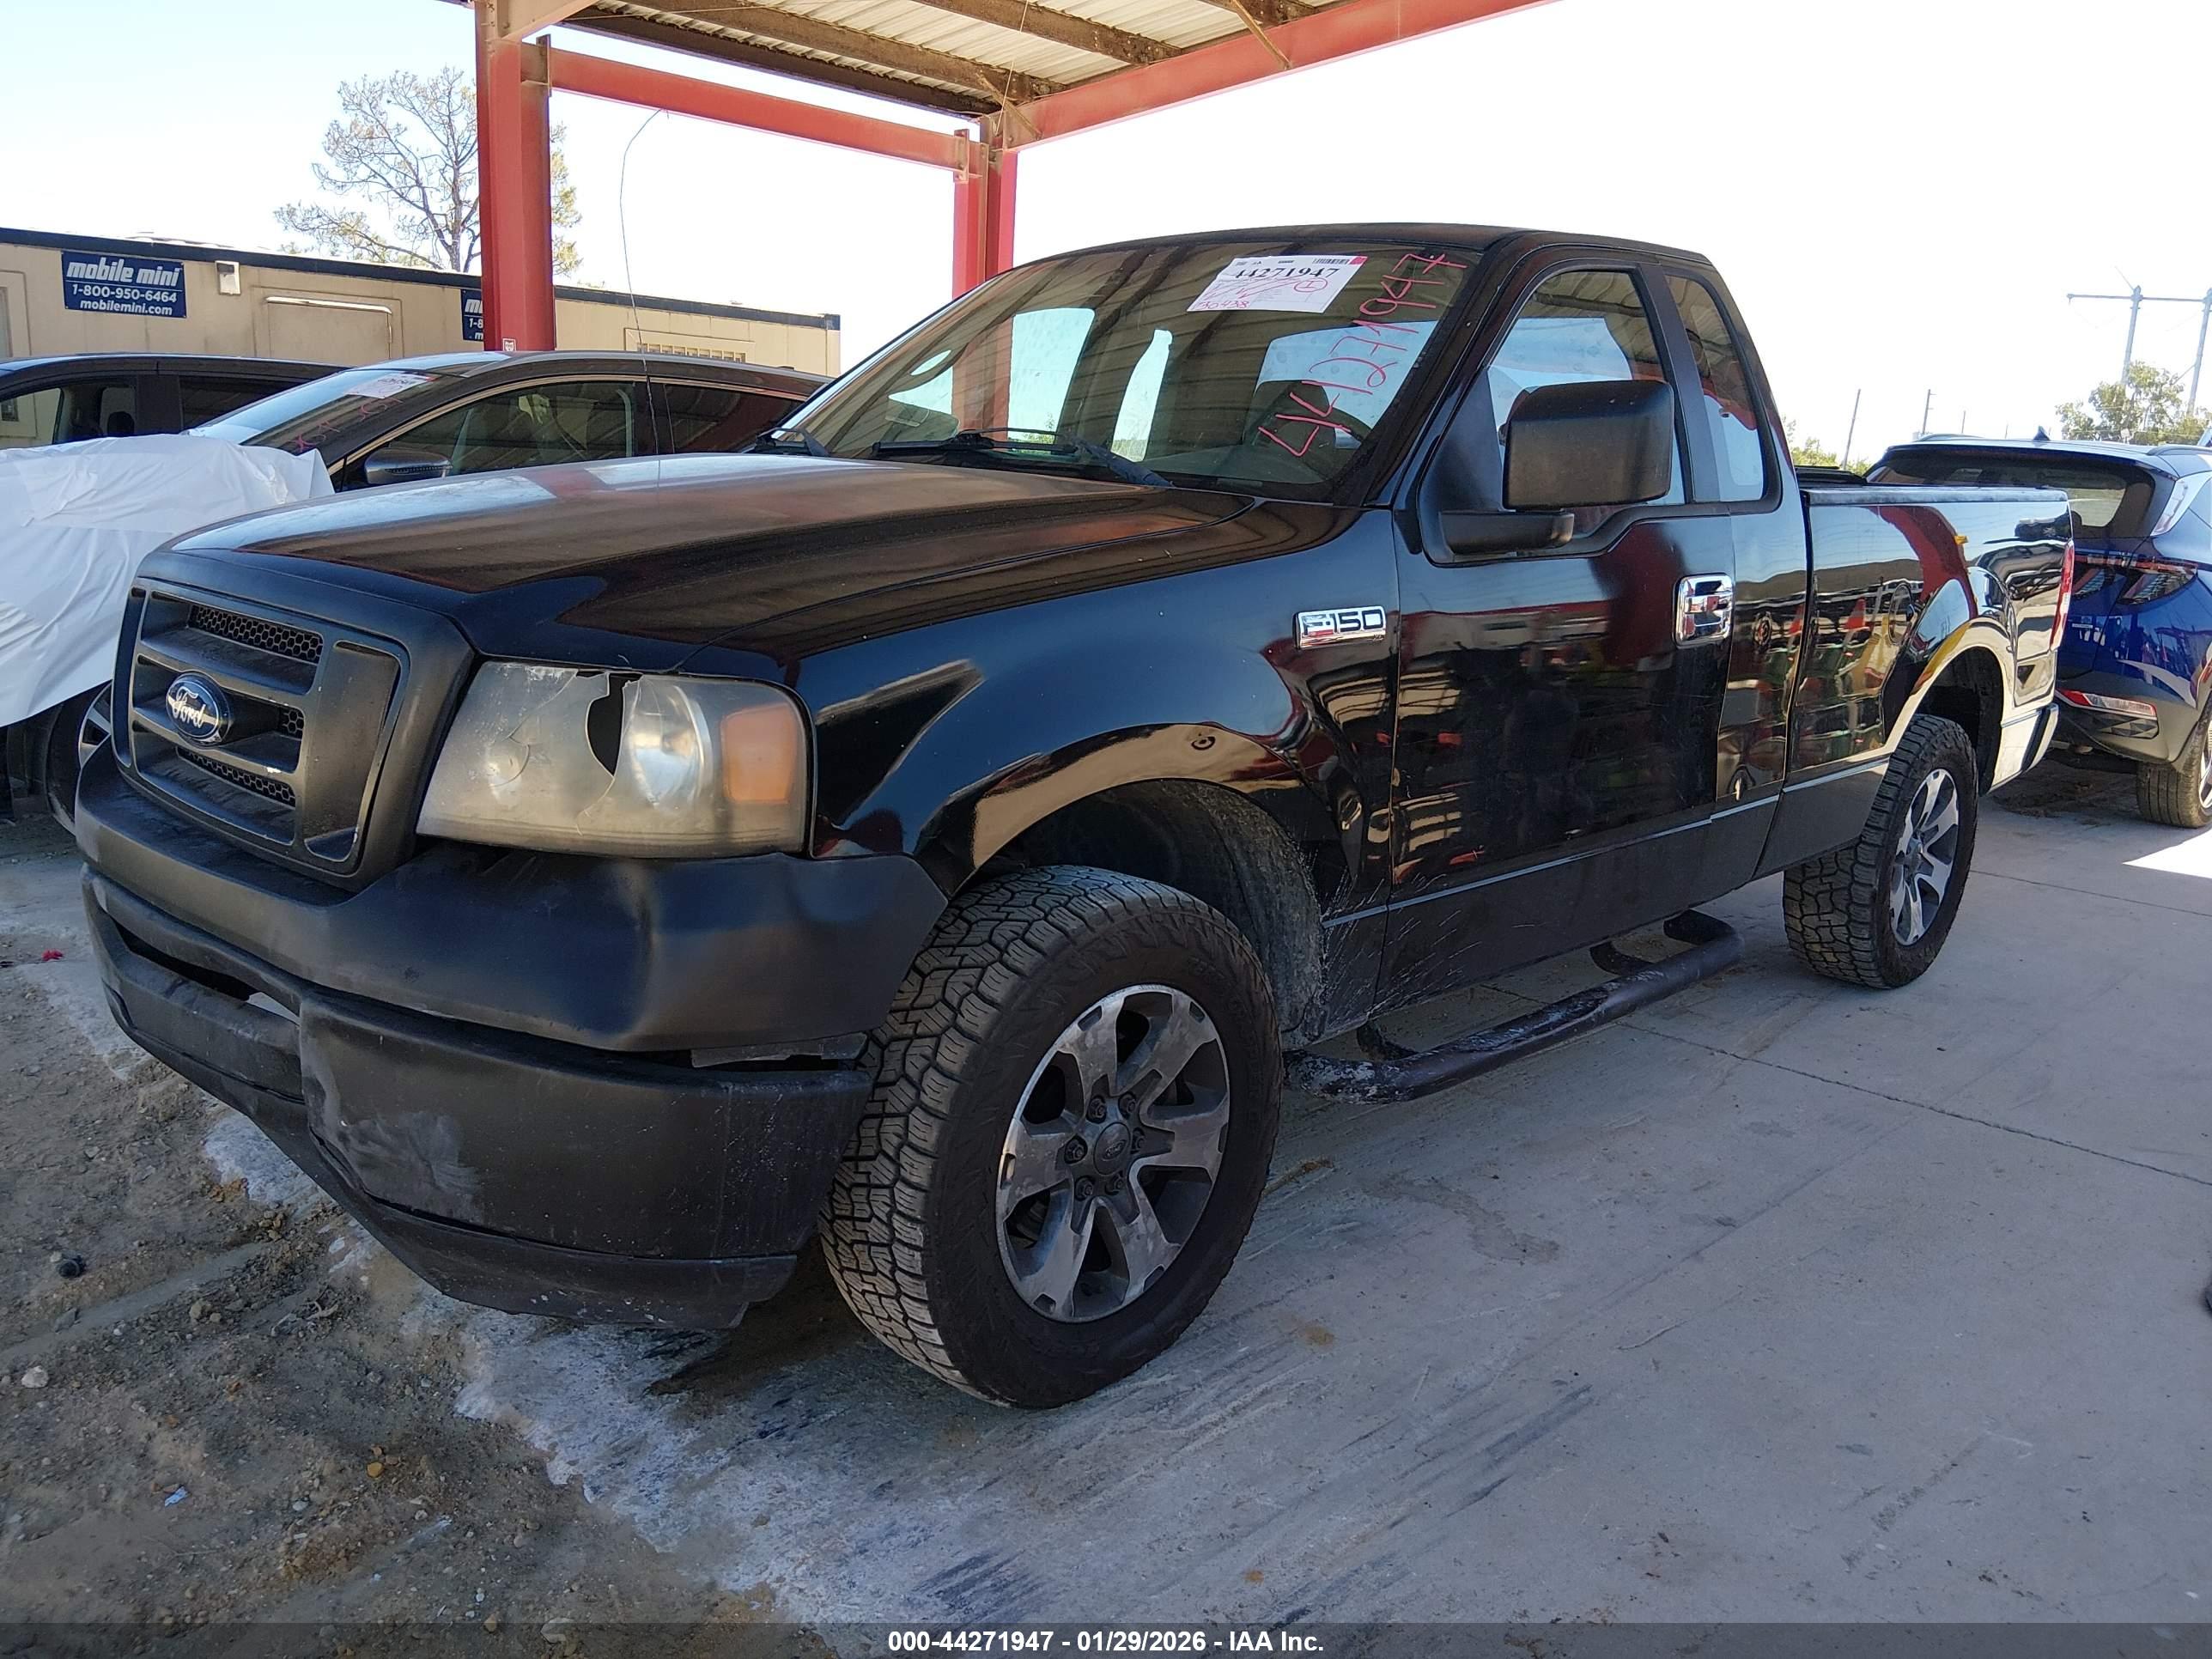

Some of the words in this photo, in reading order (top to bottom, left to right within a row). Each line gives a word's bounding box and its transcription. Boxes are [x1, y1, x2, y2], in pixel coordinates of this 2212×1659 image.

[66, 257, 134, 283] mobile
[136, 265, 181, 287] mini
[1235, 267, 1340, 279] 44271947
[72, 283, 178, 302] 1-800-950-6464
[80, 300, 173, 315] mobilemini.com
[171, 686, 206, 728] Ford
